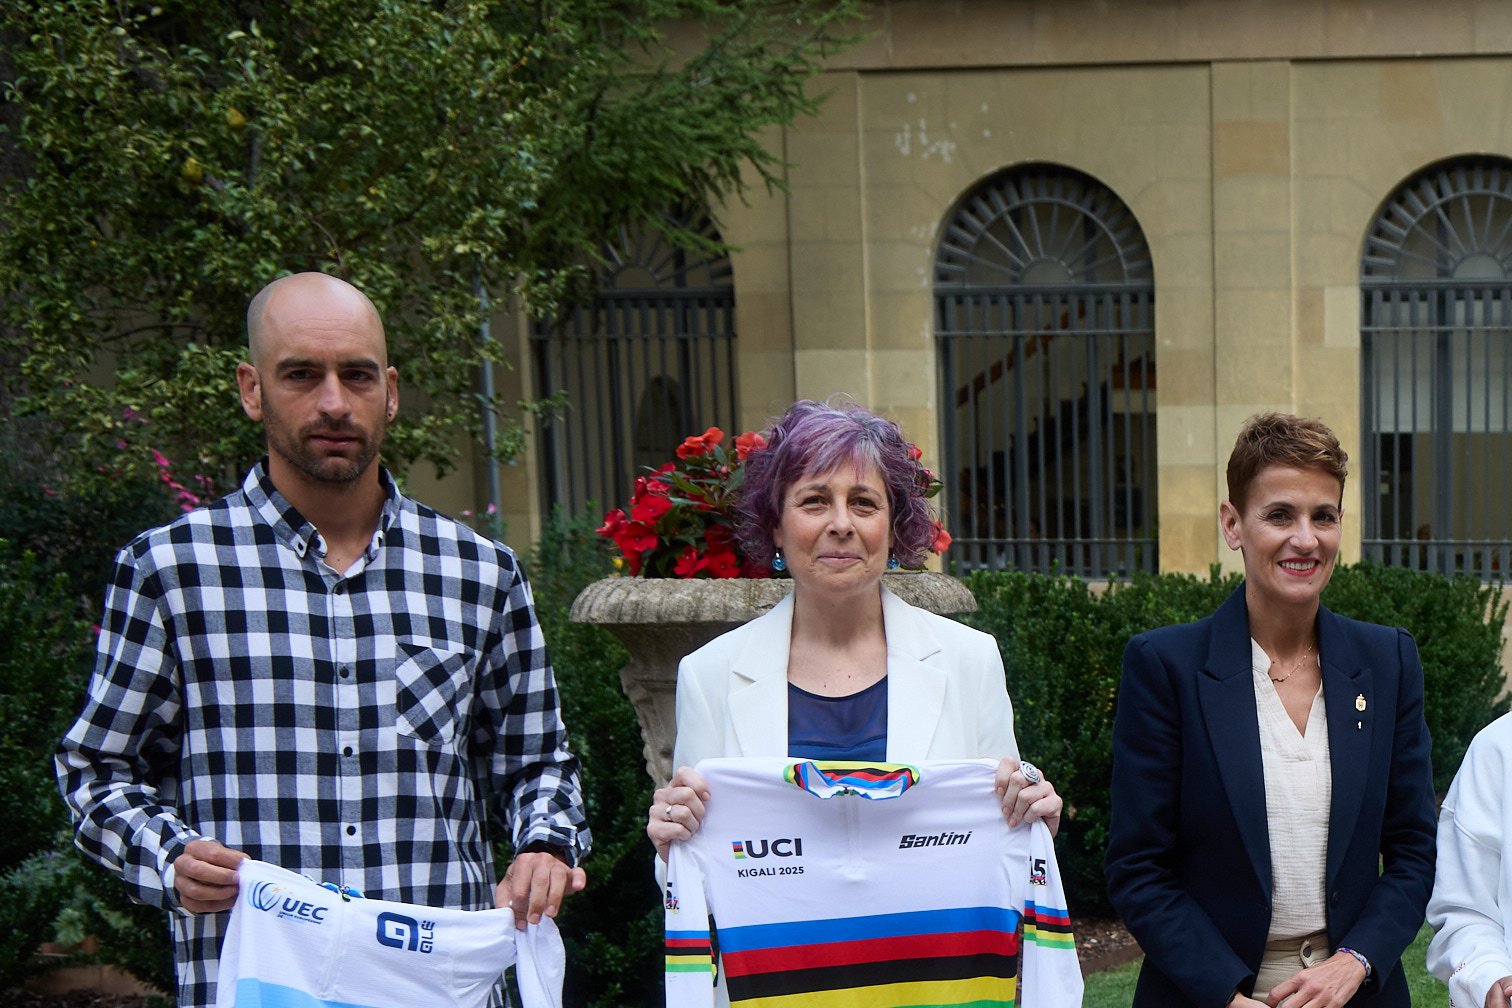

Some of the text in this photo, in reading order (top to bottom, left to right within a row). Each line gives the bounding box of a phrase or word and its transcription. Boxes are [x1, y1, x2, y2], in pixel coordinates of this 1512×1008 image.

[745, 838, 802, 858] UCI
[898, 831, 973, 849] Santini
[738, 866, 804, 878] KIGALI 2025
[282, 897, 329, 920] UEC
